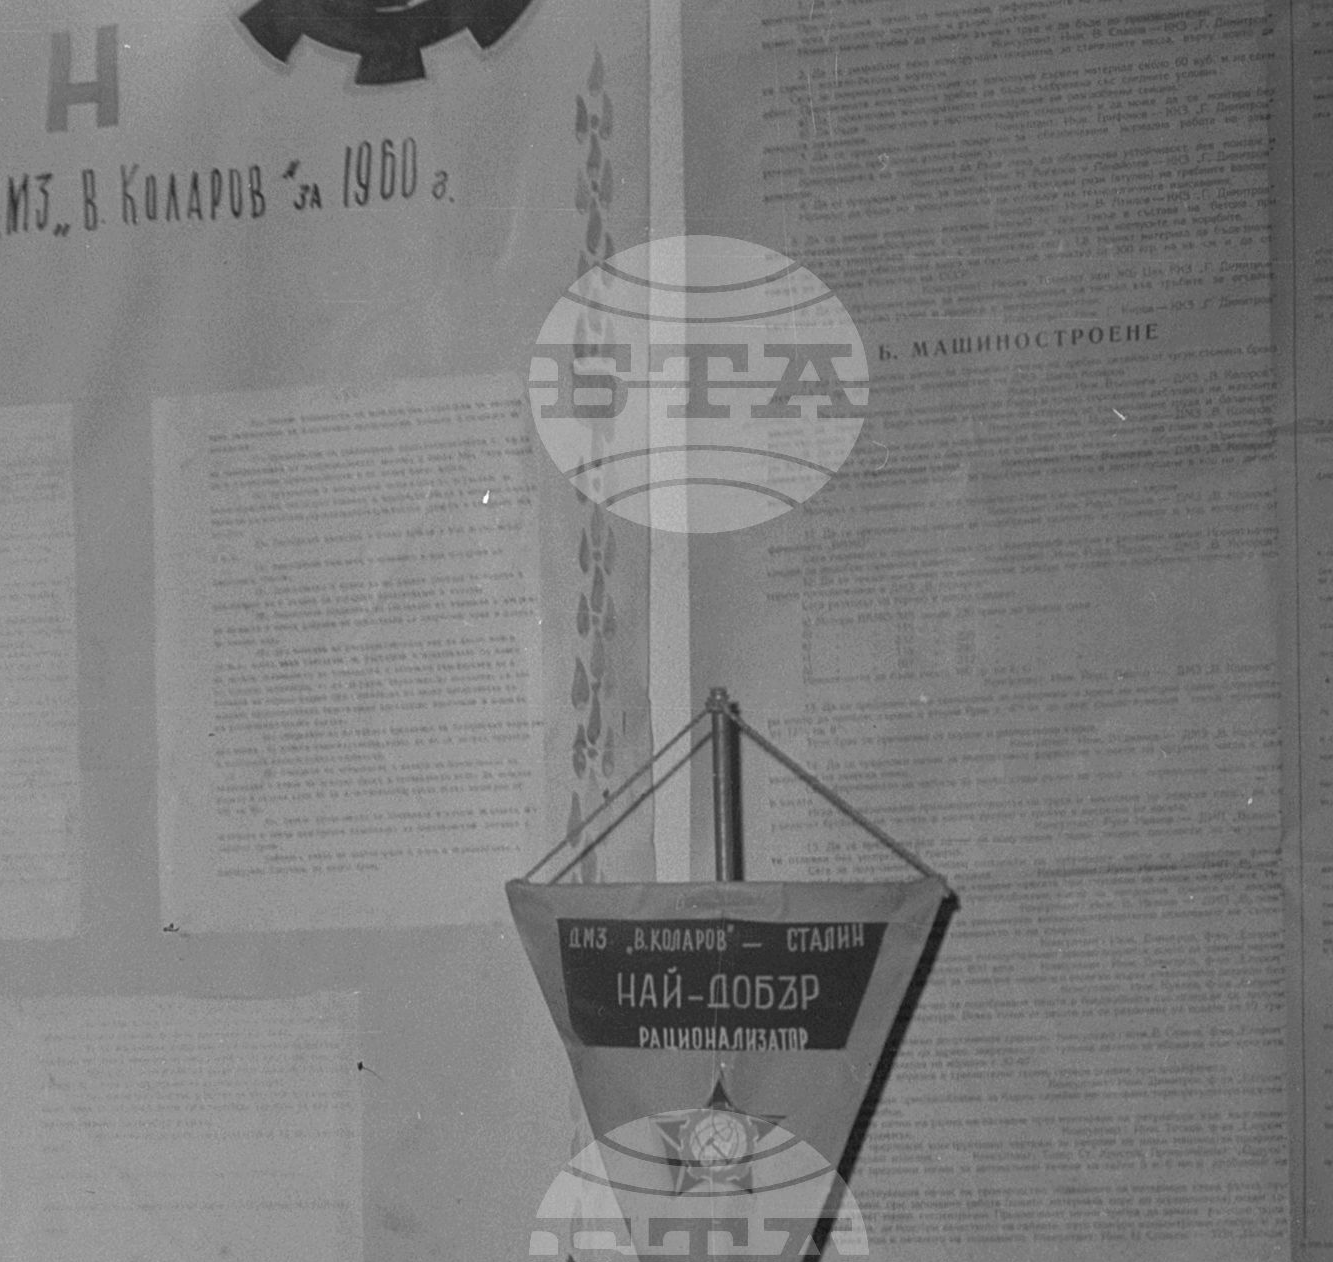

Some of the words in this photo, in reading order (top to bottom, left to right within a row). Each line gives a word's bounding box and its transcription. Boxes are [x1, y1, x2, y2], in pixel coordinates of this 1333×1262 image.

[342, 137, 418, 208] 1960
[878, 343, 898, 362] Б.
[912, 322, 1160, 360] МАШИНОСТРОЕНЕ
[569, 926, 608, 950] ДМЗ
[786, 923, 865, 953] СТАЛИН
[638, 1026, 810, 1052] РАЦИОНАЛИЗАТОР
